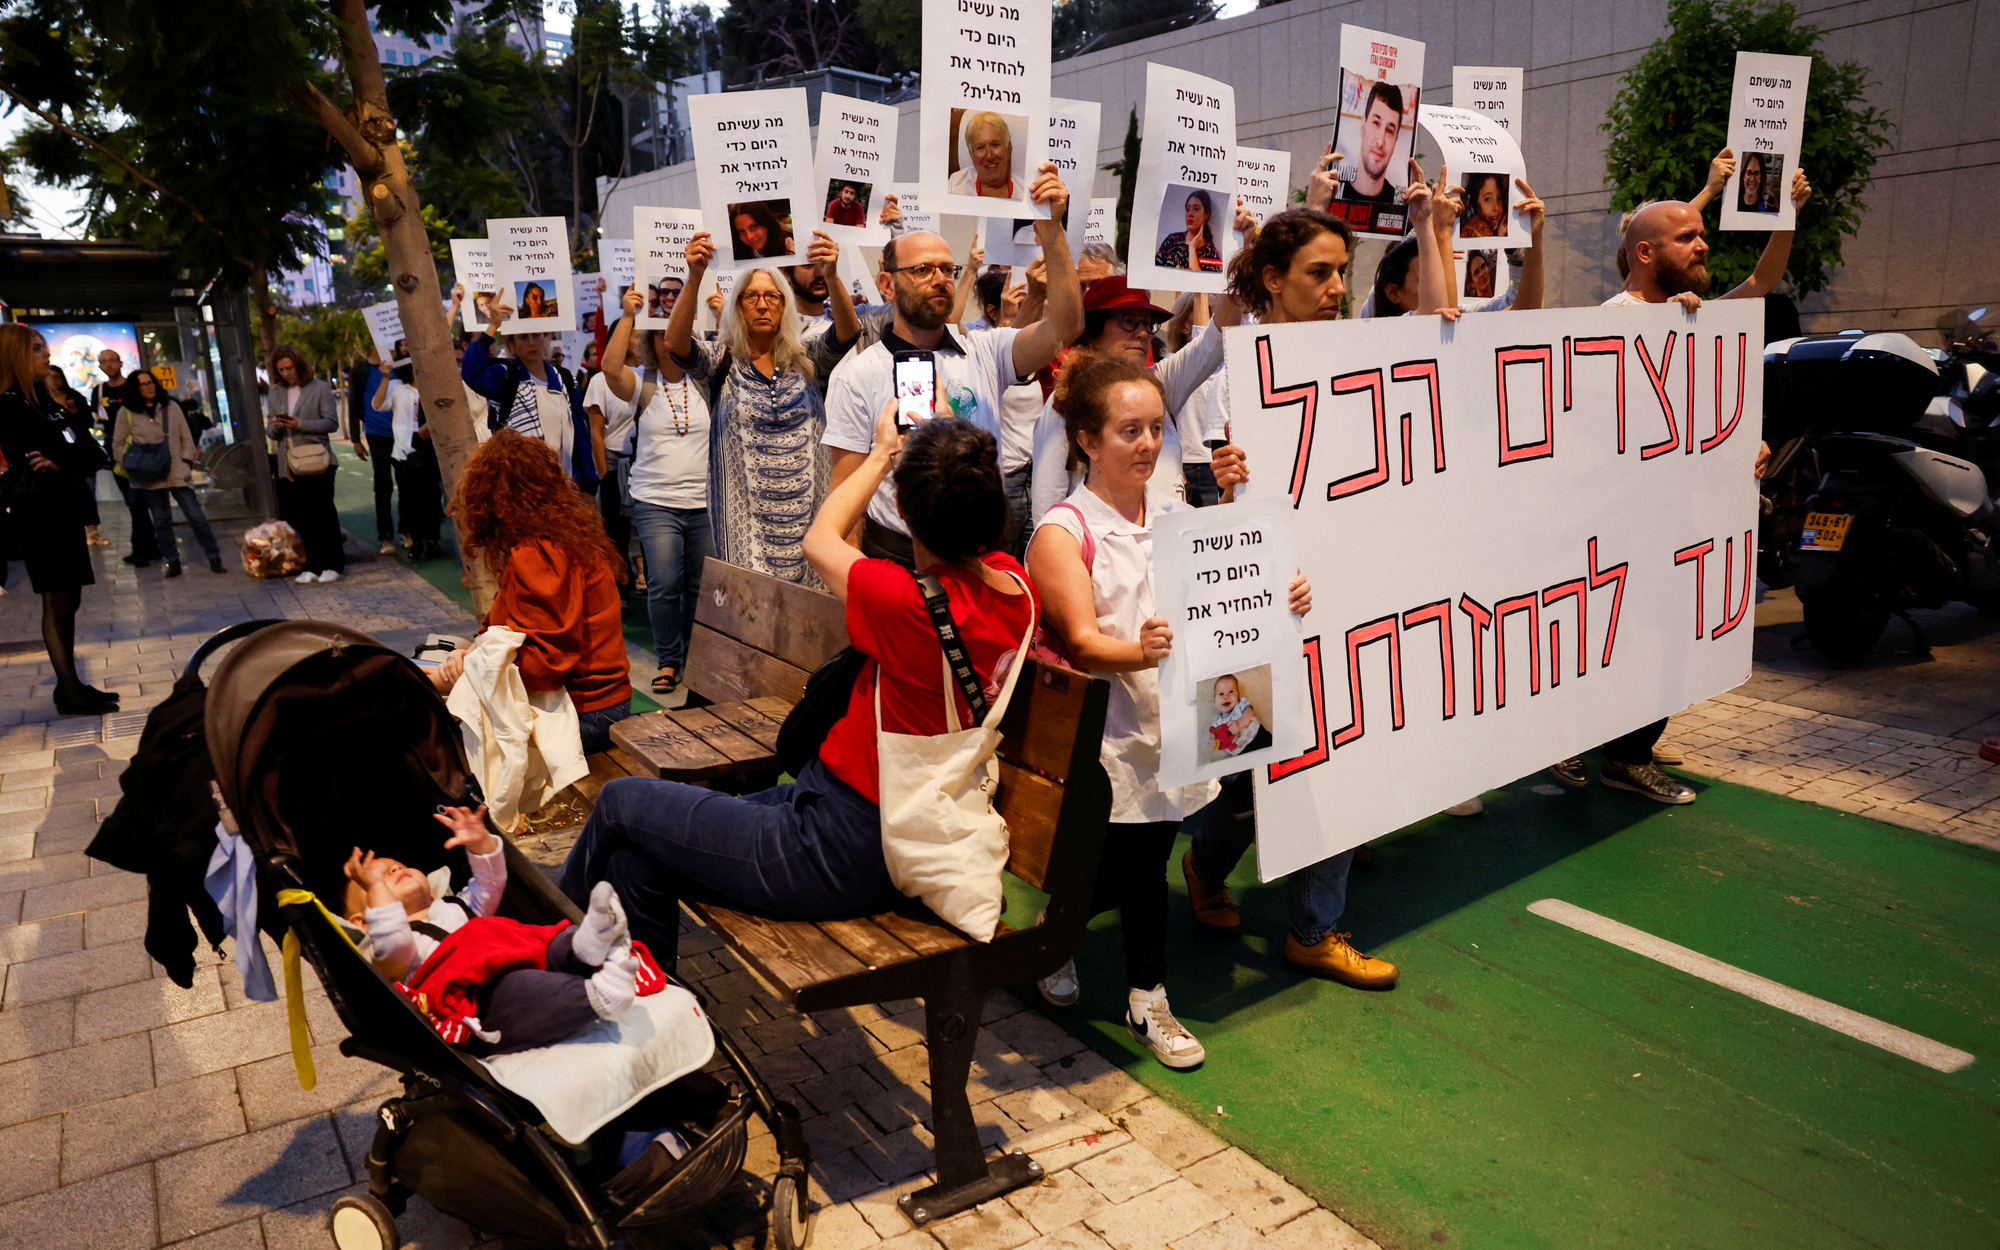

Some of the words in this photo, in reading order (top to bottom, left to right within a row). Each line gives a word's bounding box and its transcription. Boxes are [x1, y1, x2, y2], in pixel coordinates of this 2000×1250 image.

[958, 0, 994, 17] עשינו
[1000, 7, 1020, 20] מה
[960, 28, 982, 43] כדי
[987, 34, 1016, 48] היום
[950, 55, 972, 70] את
[976, 59, 1025, 77] להחזיר
[1473, 81, 1494, 91] עשינו
[1495, 81, 1507, 90] מה
[1749, 76, 1778, 89] עשיתם
[1779, 78, 1792, 89] מה
[960, 81, 1021, 104] מרגלית?
[1176, 88, 1203, 105] עשית
[1206, 97, 1220, 110] מה
[1474, 101, 1486, 110] כדי
[1488, 101, 1505, 110] היום
[1752, 97, 1765, 108] כדי
[1767, 99, 1784, 109] היום
[764, 116, 783, 128] מה
[841, 111, 865, 123] עשית
[866, 116, 879, 127] מה
[1177, 115, 1194, 129] כדי
[1744, 117, 1756, 128] את
[717, 118, 760, 131] עשיתם
[1060, 118, 1076, 129] מה
[1198, 118, 1219, 134] היום
[1759, 118, 1787, 130] להחזיר
[841, 129, 855, 141] כדי
[858, 132, 876, 144] היום
[1448, 136, 1465, 144] את
[1464, 136, 1498, 146] להחזיר
[726, 140, 746, 151] כדי
[751, 138, 778, 150] היום
[1048, 138, 1071, 149] היום
[1167, 140, 1185, 154] את
[1754, 137, 1774, 150] נילי?
[833, 146, 847, 156] את
[849, 148, 880, 161] להחזיר
[1189, 143, 1226, 160] להחזיר
[1469, 151, 1494, 164] נווה?
[720, 162, 740, 173] את
[743, 157, 788, 172] להחזיר
[844, 163, 870, 177] הרש?
[1048, 158, 1077, 170] להח
[1237, 160, 1260, 171] עשית
[1263, 163, 1276, 172] מה
[1180, 165, 1218, 185] דפנה?
[1237, 176, 1248, 185] כד
[735, 180, 778, 193] דניאל?
[1251, 179, 1269, 188] היום
[1243, 195, 1273, 205] להחזיר
[1348, 203, 1373, 223] NOW!
[509, 226, 533, 234] עשית
[654, 221, 678, 230] עשית
[529, 239, 548, 247] היום
[656, 236, 670, 244] כדי
[1084, 233, 1104, 242] להחזי
[524, 251, 555, 260] להחזיר
[649, 250, 664, 258] את
[666, 251, 686, 259] חזיר
[525, 265, 546, 275] עדן?
[663, 263, 685, 273] אור?
[161, 367, 172, 376] 71
[1494, 330, 1748, 468] עוצרים
[1254, 334, 1447, 511] הכל
[1240, 529, 1263, 546] מה
[1816, 529, 1837, 541] 502
[1192, 533, 1234, 554] עשית
[1196, 569, 1221, 585] כדי
[1227, 563, 1260, 581] היום
[1674, 529, 1754, 641] עד
[1217, 589, 1273, 615] להחזיר
[1187, 602, 1212, 621] את
[1213, 627, 1260, 649] כפיר?
